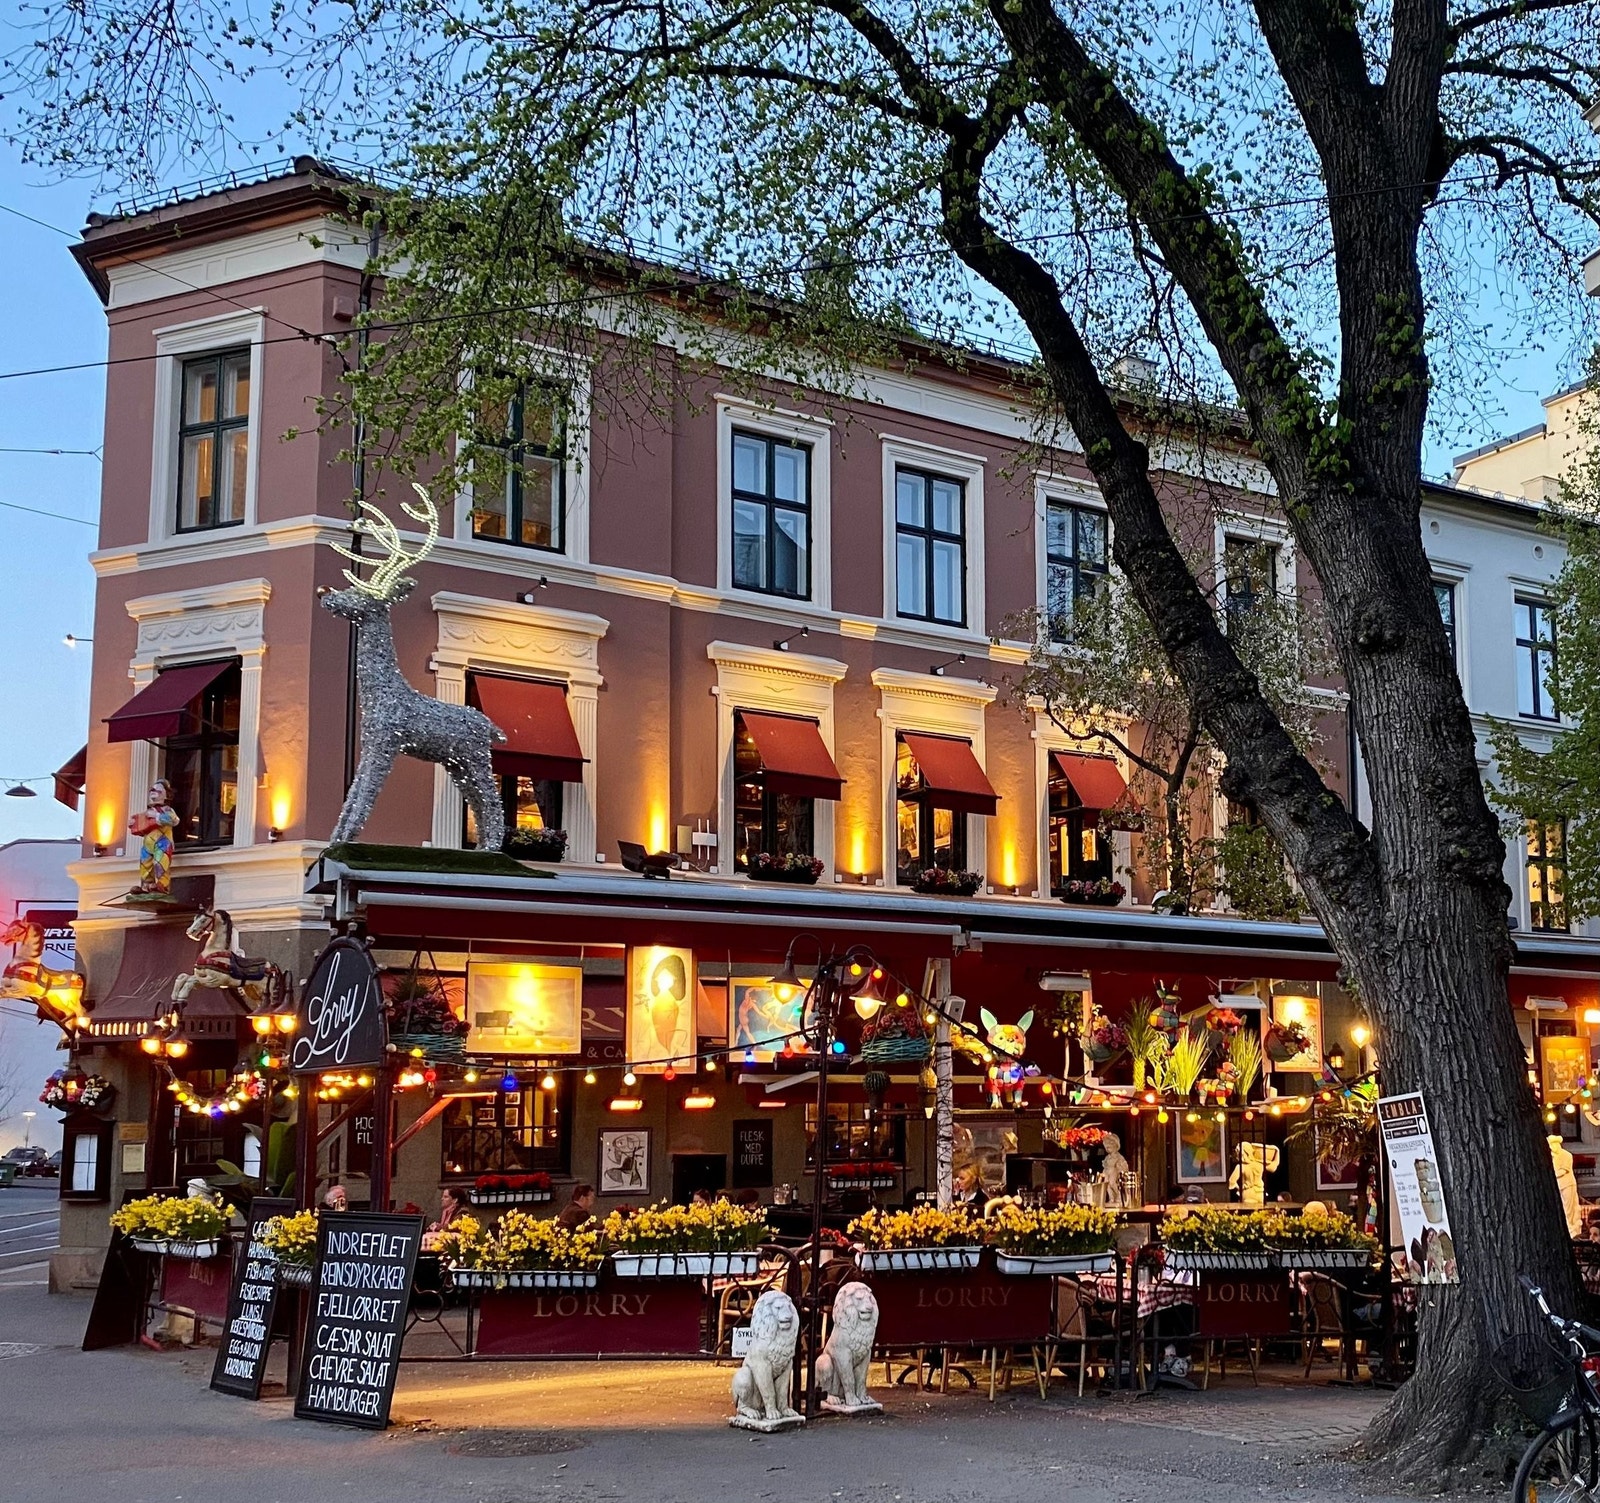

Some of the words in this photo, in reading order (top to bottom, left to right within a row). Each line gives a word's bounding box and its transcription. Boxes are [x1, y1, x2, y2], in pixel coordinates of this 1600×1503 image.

[293, 951, 371, 1069] Lorry
[1384, 1100, 1418, 1119] EMBLA
[740, 1130, 764, 1142] FLESK
[745, 1142, 761, 1153] MED
[327, 1230, 412, 1258] INDREFILET
[320, 1261, 406, 1290] REINSDYRKAKER
[533, 1293, 653, 1318] LORRY
[917, 1285, 1014, 1308] LORRY
[1206, 1283, 1281, 1303] LORRY
[316, 1293, 401, 1323] FJELLØRRET
[317, 1324, 362, 1354] CÆSAR
[362, 1330, 396, 1358] SALAT
[309, 1354, 358, 1384] CHEVRE
[357, 1360, 391, 1388] SALAT
[308, 1383, 381, 1416] HAMBURGER
